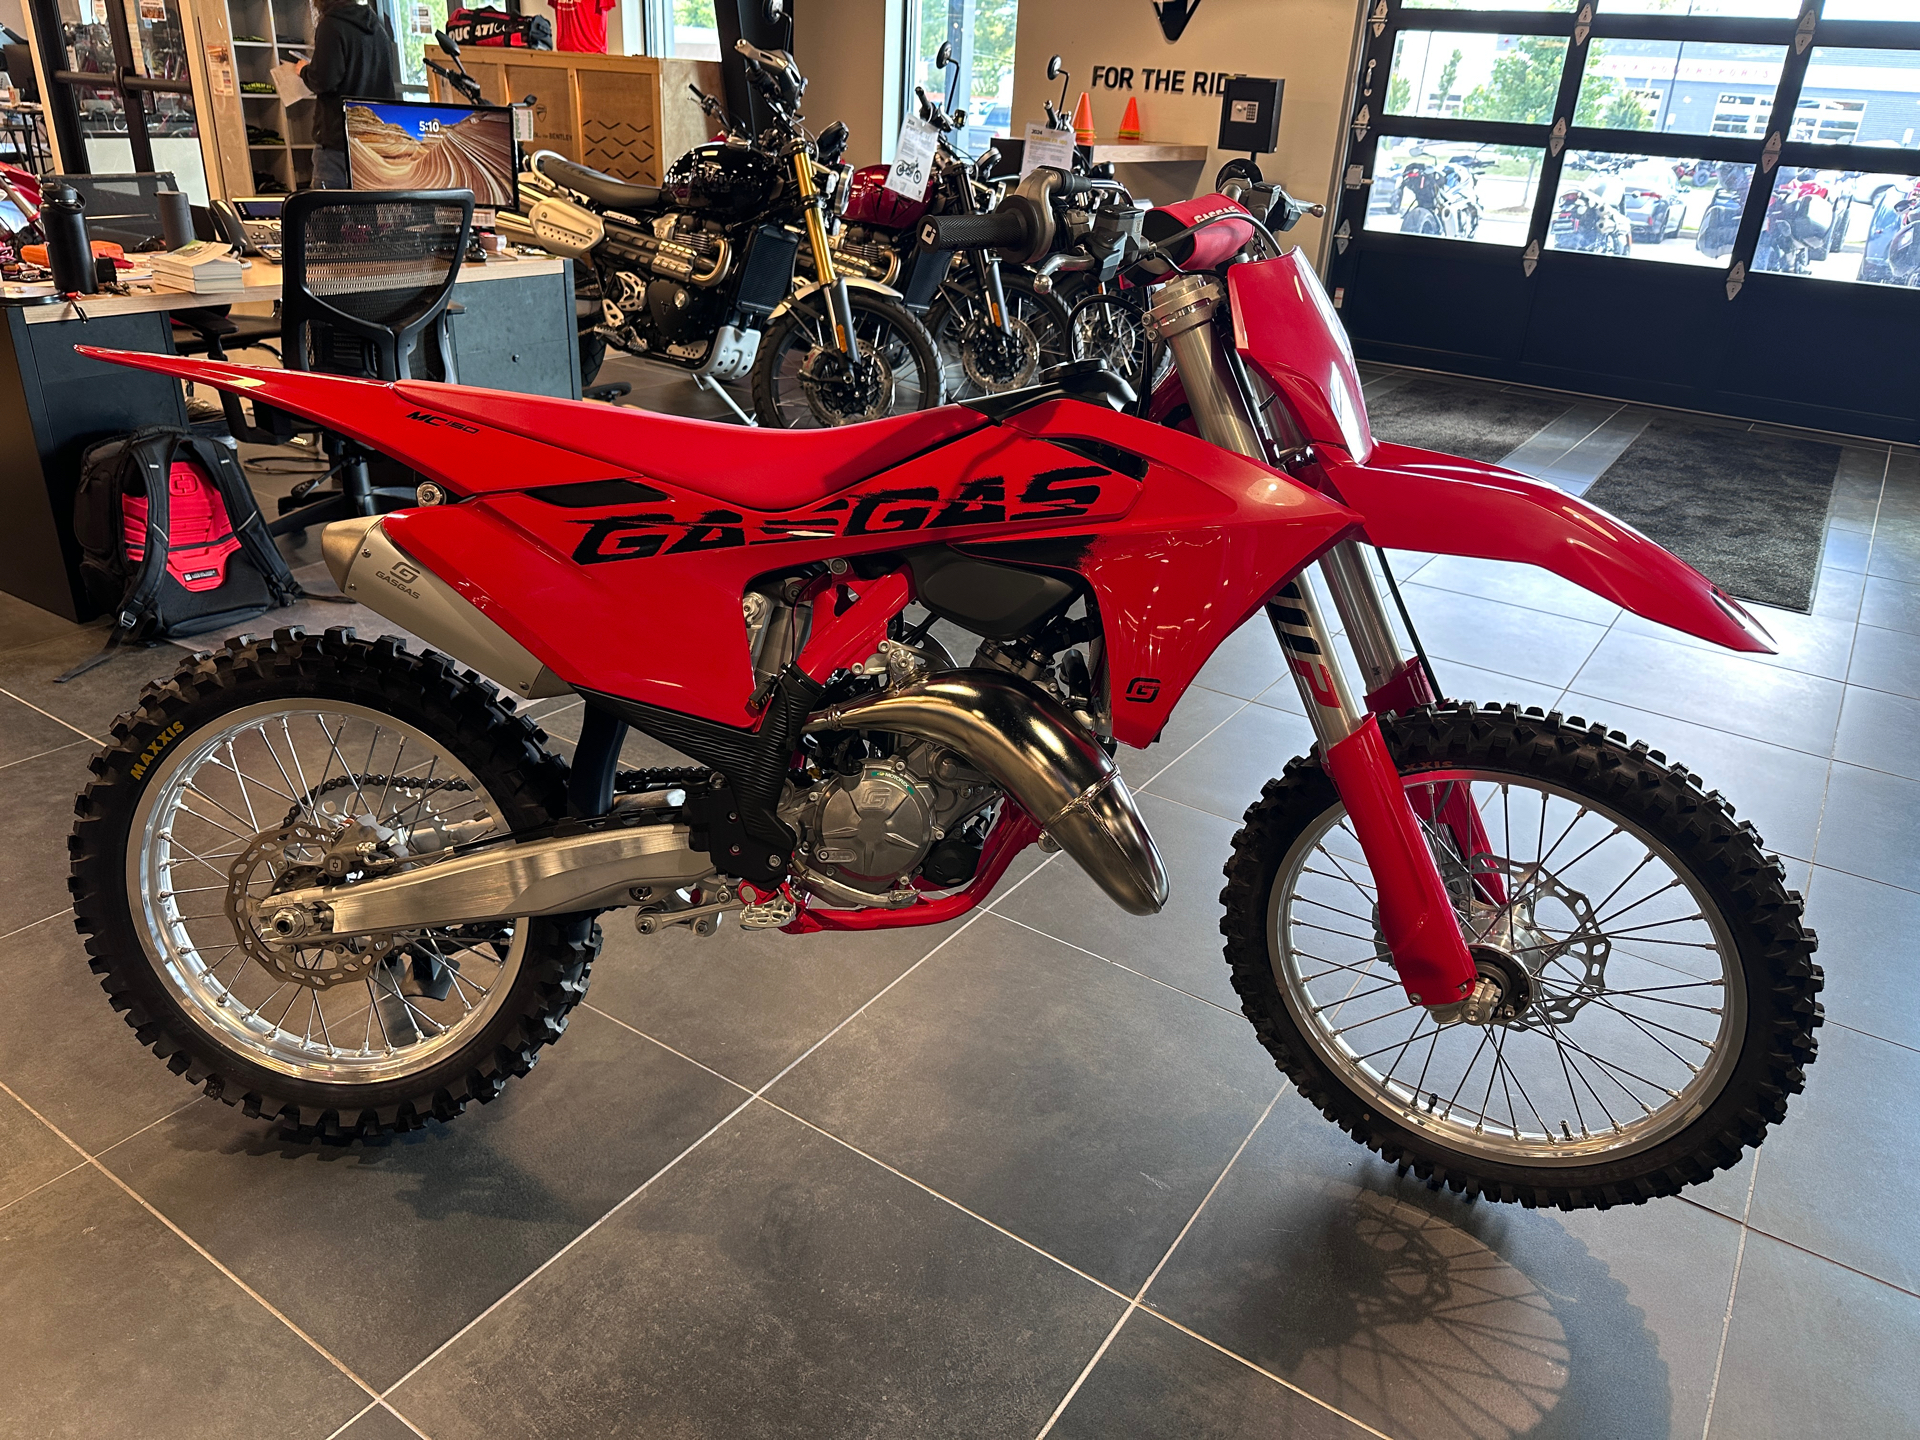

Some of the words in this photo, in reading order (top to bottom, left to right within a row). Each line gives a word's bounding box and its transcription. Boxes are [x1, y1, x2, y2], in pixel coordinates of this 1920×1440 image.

[1091, 65, 1134, 90] FOR
[1142, 68, 1186, 94] THE
[1192, 71, 1246, 97] RID
[419, 120, 440, 132] 5:10
[563, 467, 1112, 565] GASGAS
[375, 570, 421, 600] GASGAS
[130, 720, 185, 781] MAXXIS
[884, 772, 910, 789] MOTOREX
[1402, 760, 1454, 772] XXIS
